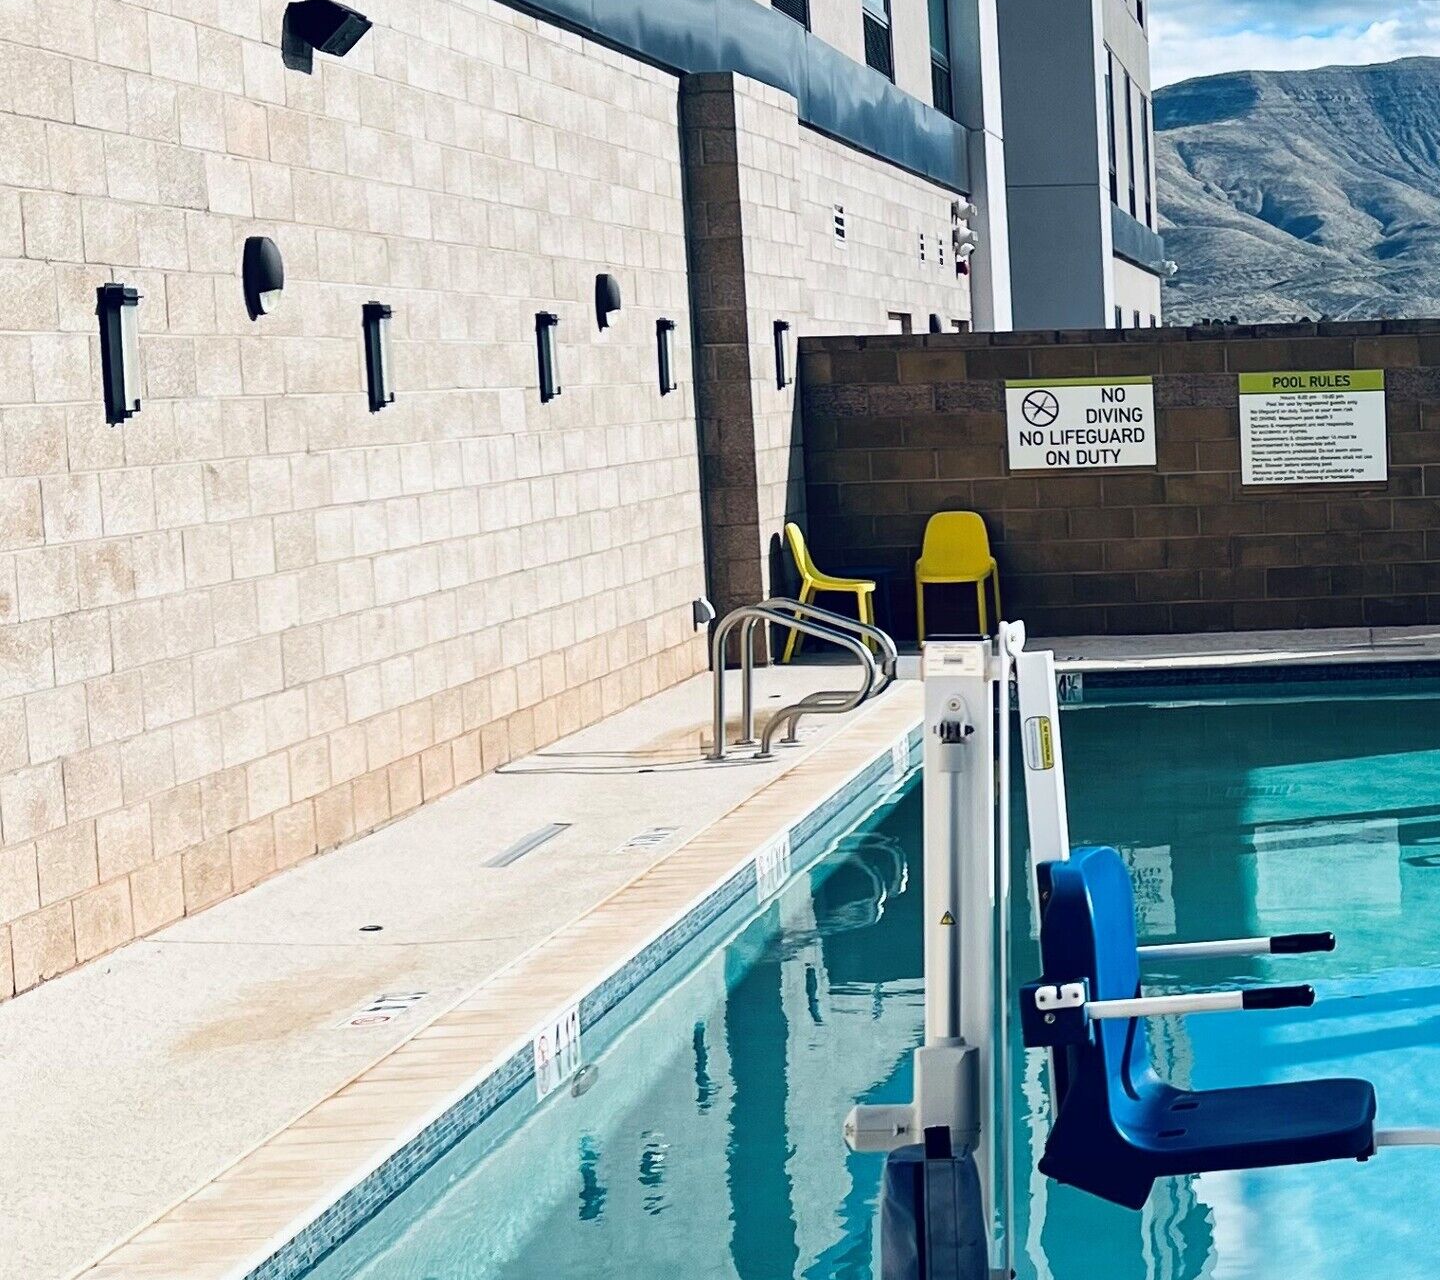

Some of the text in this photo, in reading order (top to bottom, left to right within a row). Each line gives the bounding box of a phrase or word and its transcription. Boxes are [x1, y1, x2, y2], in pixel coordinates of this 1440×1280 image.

[1272, 374, 1351, 389] POOL RULES
[1101, 387, 1126, 404] NO
[1086, 407, 1143, 424] DIVING
[1019, 427, 1145, 447] NO LIFEGUARD
[1045, 448, 1122, 466] ON DUTY
